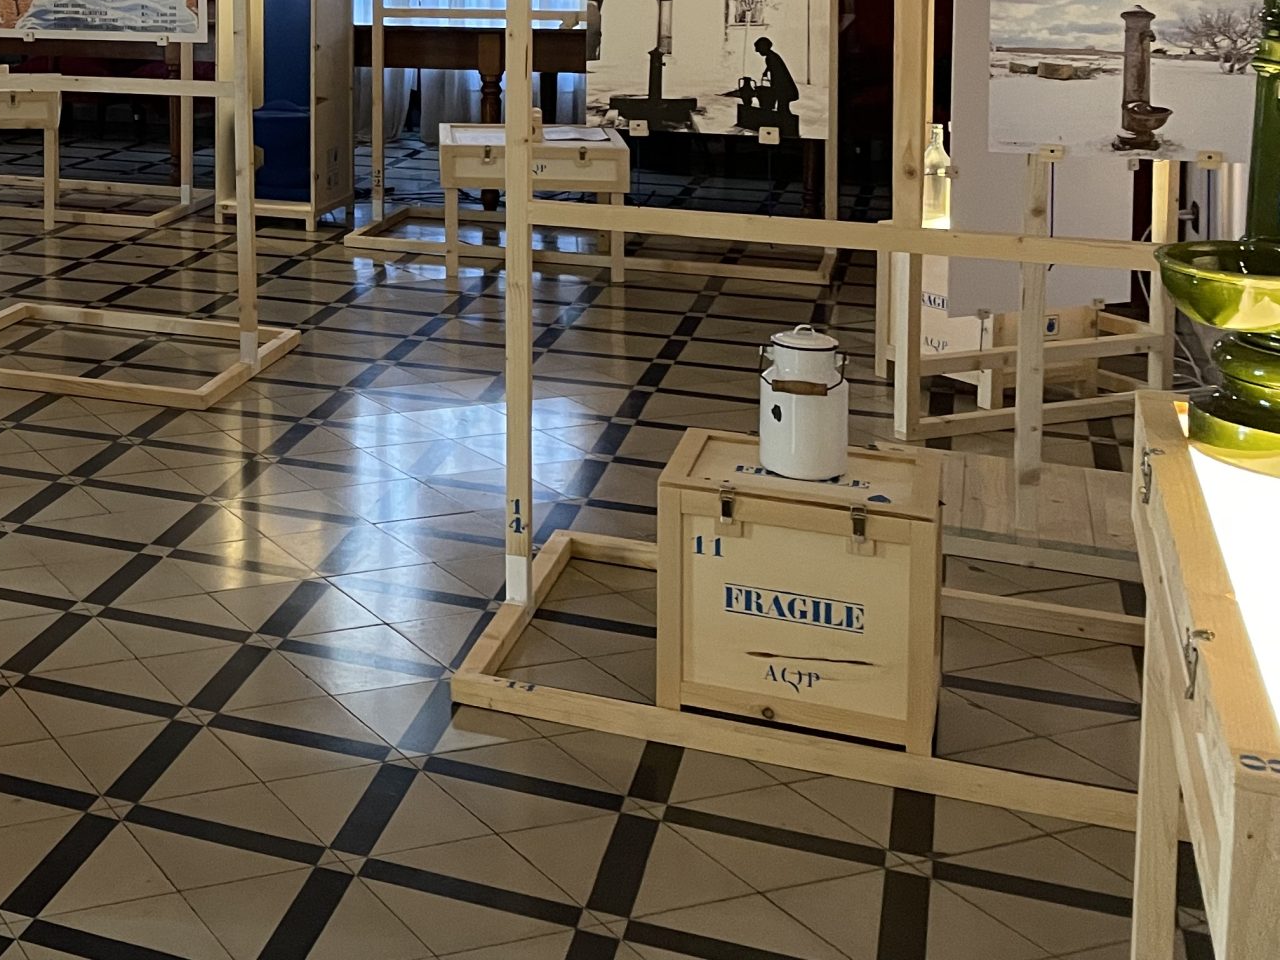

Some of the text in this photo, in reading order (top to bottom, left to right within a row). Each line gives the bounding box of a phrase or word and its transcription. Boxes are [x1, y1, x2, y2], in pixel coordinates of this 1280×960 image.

[692, 535, 724, 558] 11
[725, 586, 864, 630] FRAGILE
[764, 664, 821, 694] AQP
